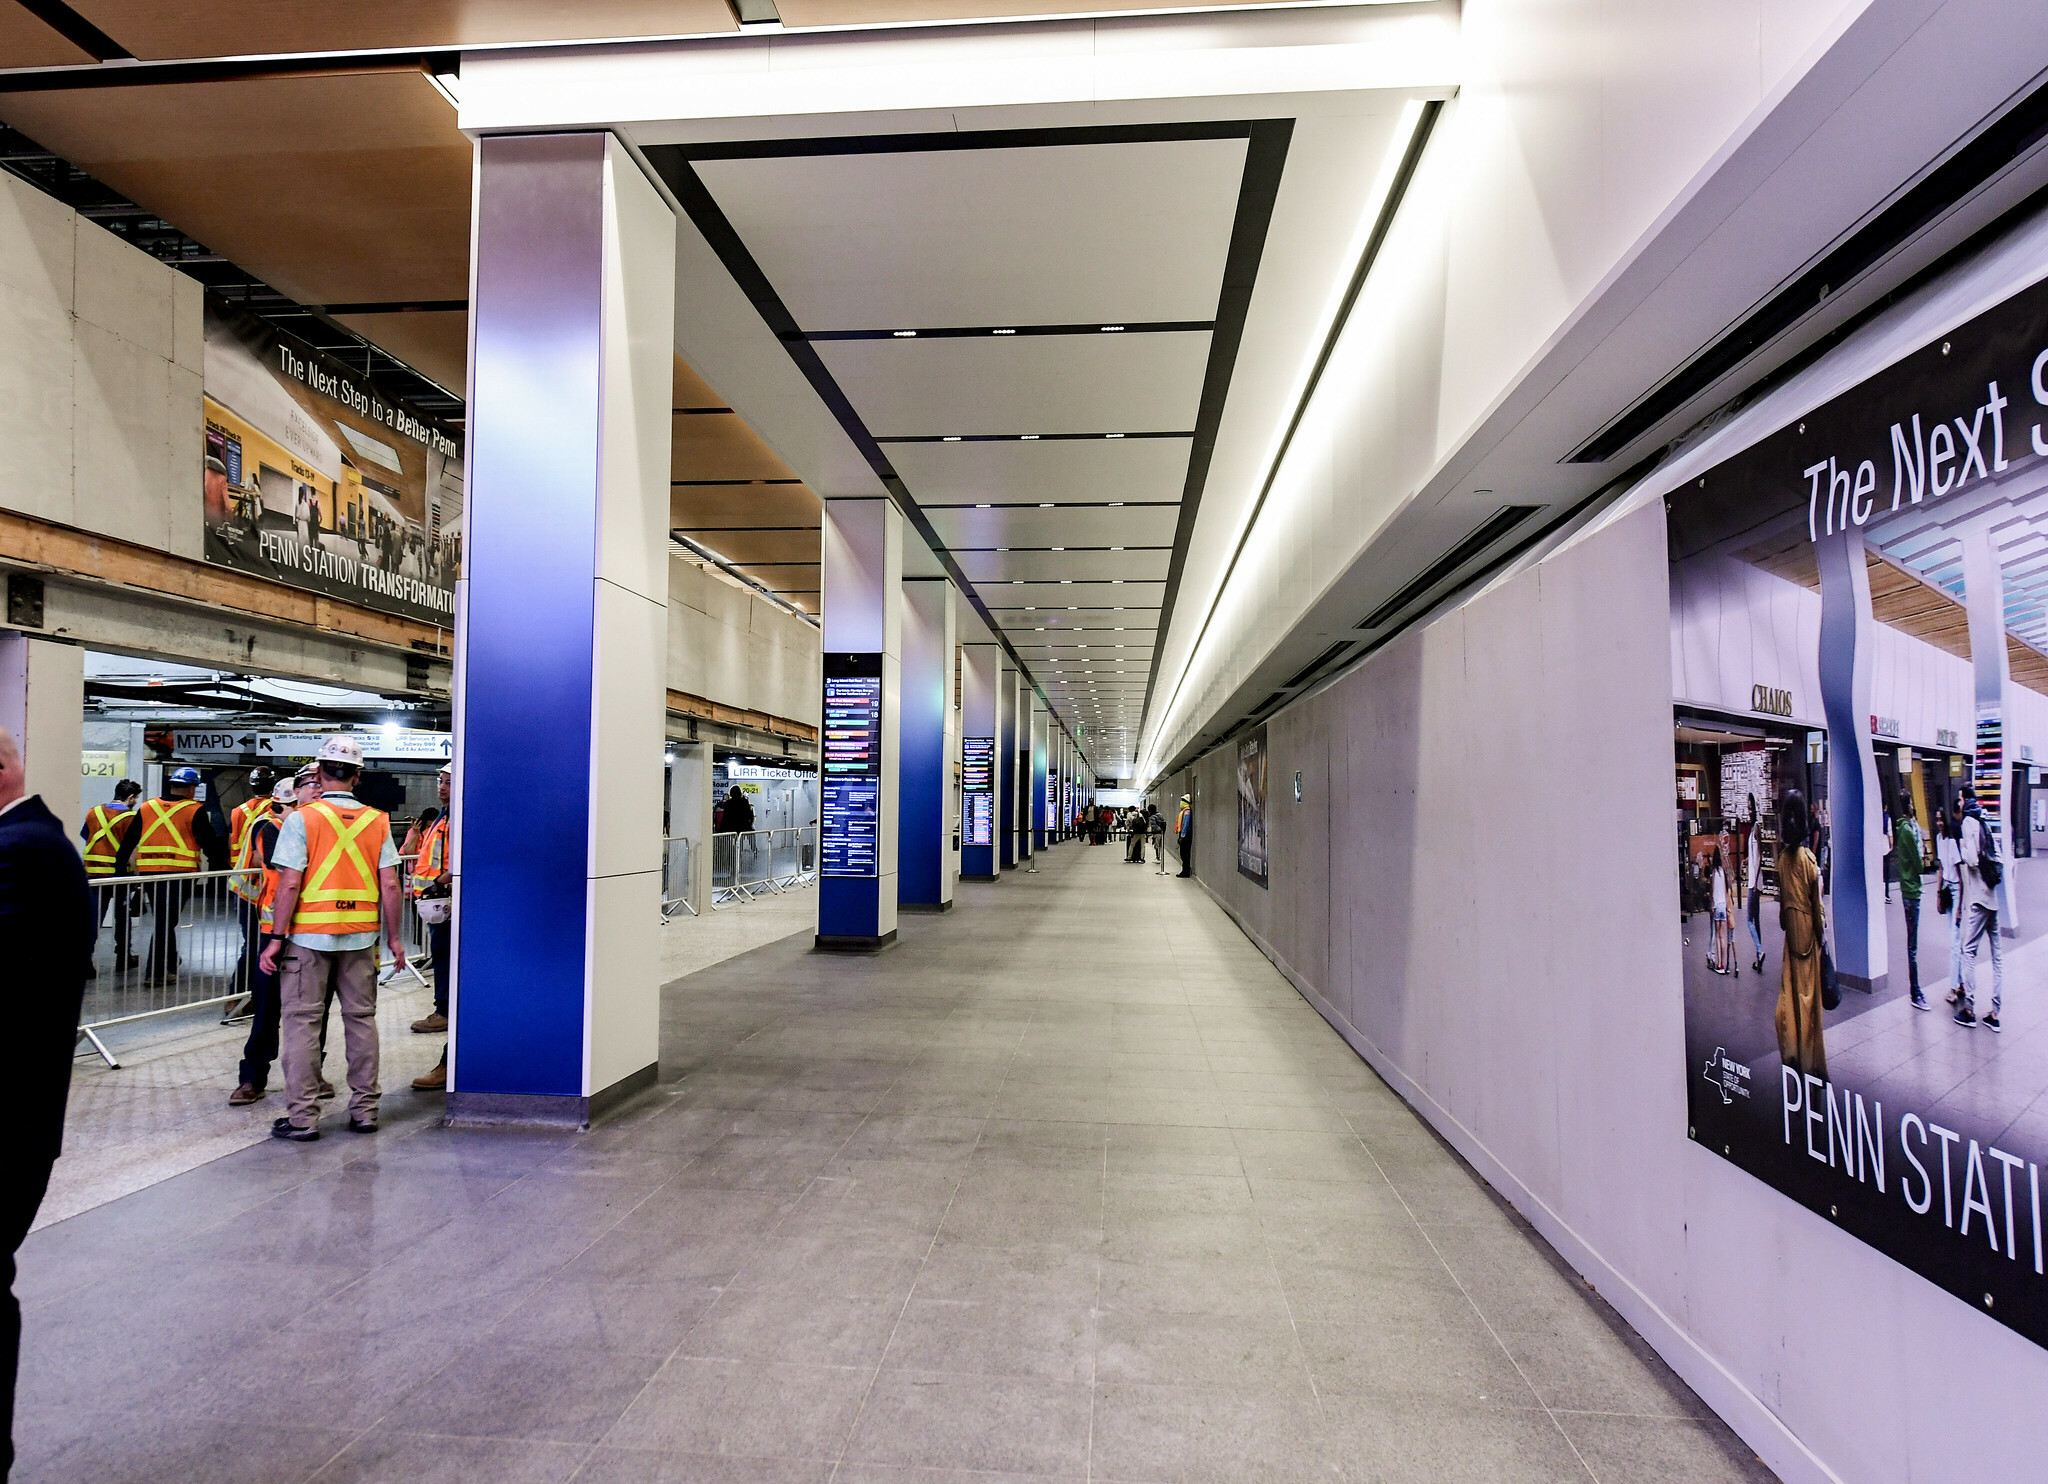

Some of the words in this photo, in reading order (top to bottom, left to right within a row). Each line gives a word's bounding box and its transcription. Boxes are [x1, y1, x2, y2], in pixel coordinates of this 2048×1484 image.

[279, 344, 304, 380] The
[308, 361, 338, 399] Next
[341, 379, 369, 418] Step
[372, 396, 383, 422] to
[386, 408, 394, 427] a
[396, 408, 430, 445] Better
[432, 427, 457, 459] Penn
[1803, 456, 1876, 542] The
[1890, 381, 2008, 511] Next
[260, 530, 299, 569] PENN
[303, 544, 357, 586] STATION
[1752, 684, 1792, 716] CHAIOS
[177, 734, 234, 749] MTAPD
[81, 763, 115, 776] 0-21
[733, 767, 758, 777] LIRR
[760, 768, 791, 778] Ticket
[1721, 1057, 1736, 1073] NEW
[1735, 1062, 1751, 1080] YORK
[1781, 1064, 1886, 1194] PENN
[1900, 1112, 2044, 1275] STATI
